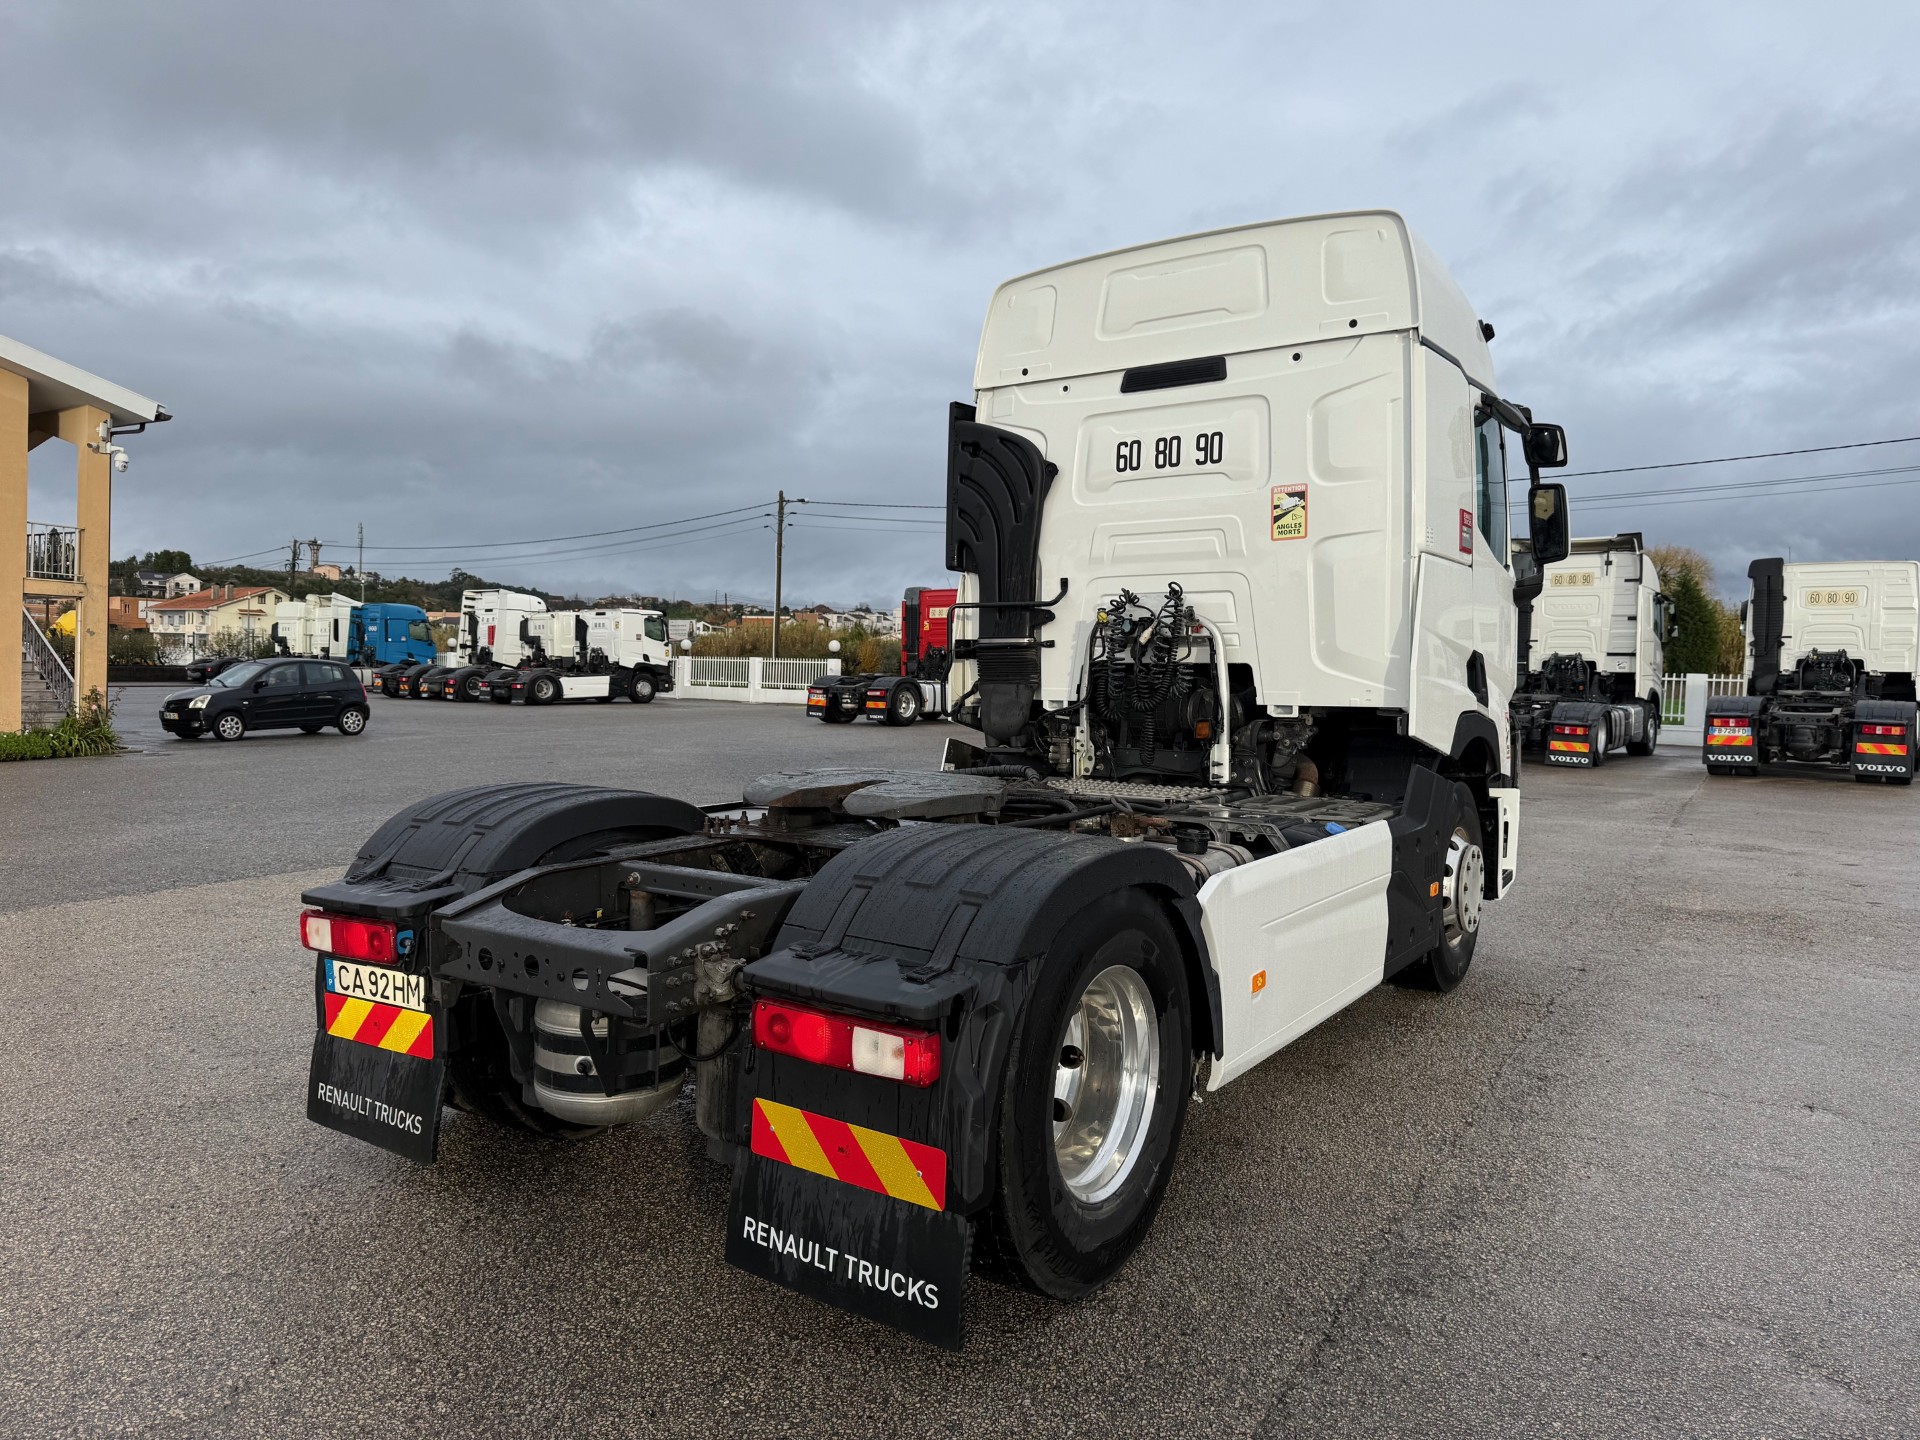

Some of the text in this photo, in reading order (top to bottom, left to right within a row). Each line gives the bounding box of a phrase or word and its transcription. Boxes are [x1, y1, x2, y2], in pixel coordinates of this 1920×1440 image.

[1116, 431, 1223, 473] 60 80 90
[1273, 485, 1305, 493] ATTENTION
[1554, 574, 1591, 585] 60 80 90
[1810, 592, 1855, 604] 60 80 90
[1549, 755, 1589, 764] VOLVO
[1707, 754, 1753, 762] VOLVO
[1855, 763, 1907, 773] VOLVO
[317, 1082, 423, 1135] RENAULT TRUCKS
[743, 1215, 940, 1311] RENAULT TRUCKS
